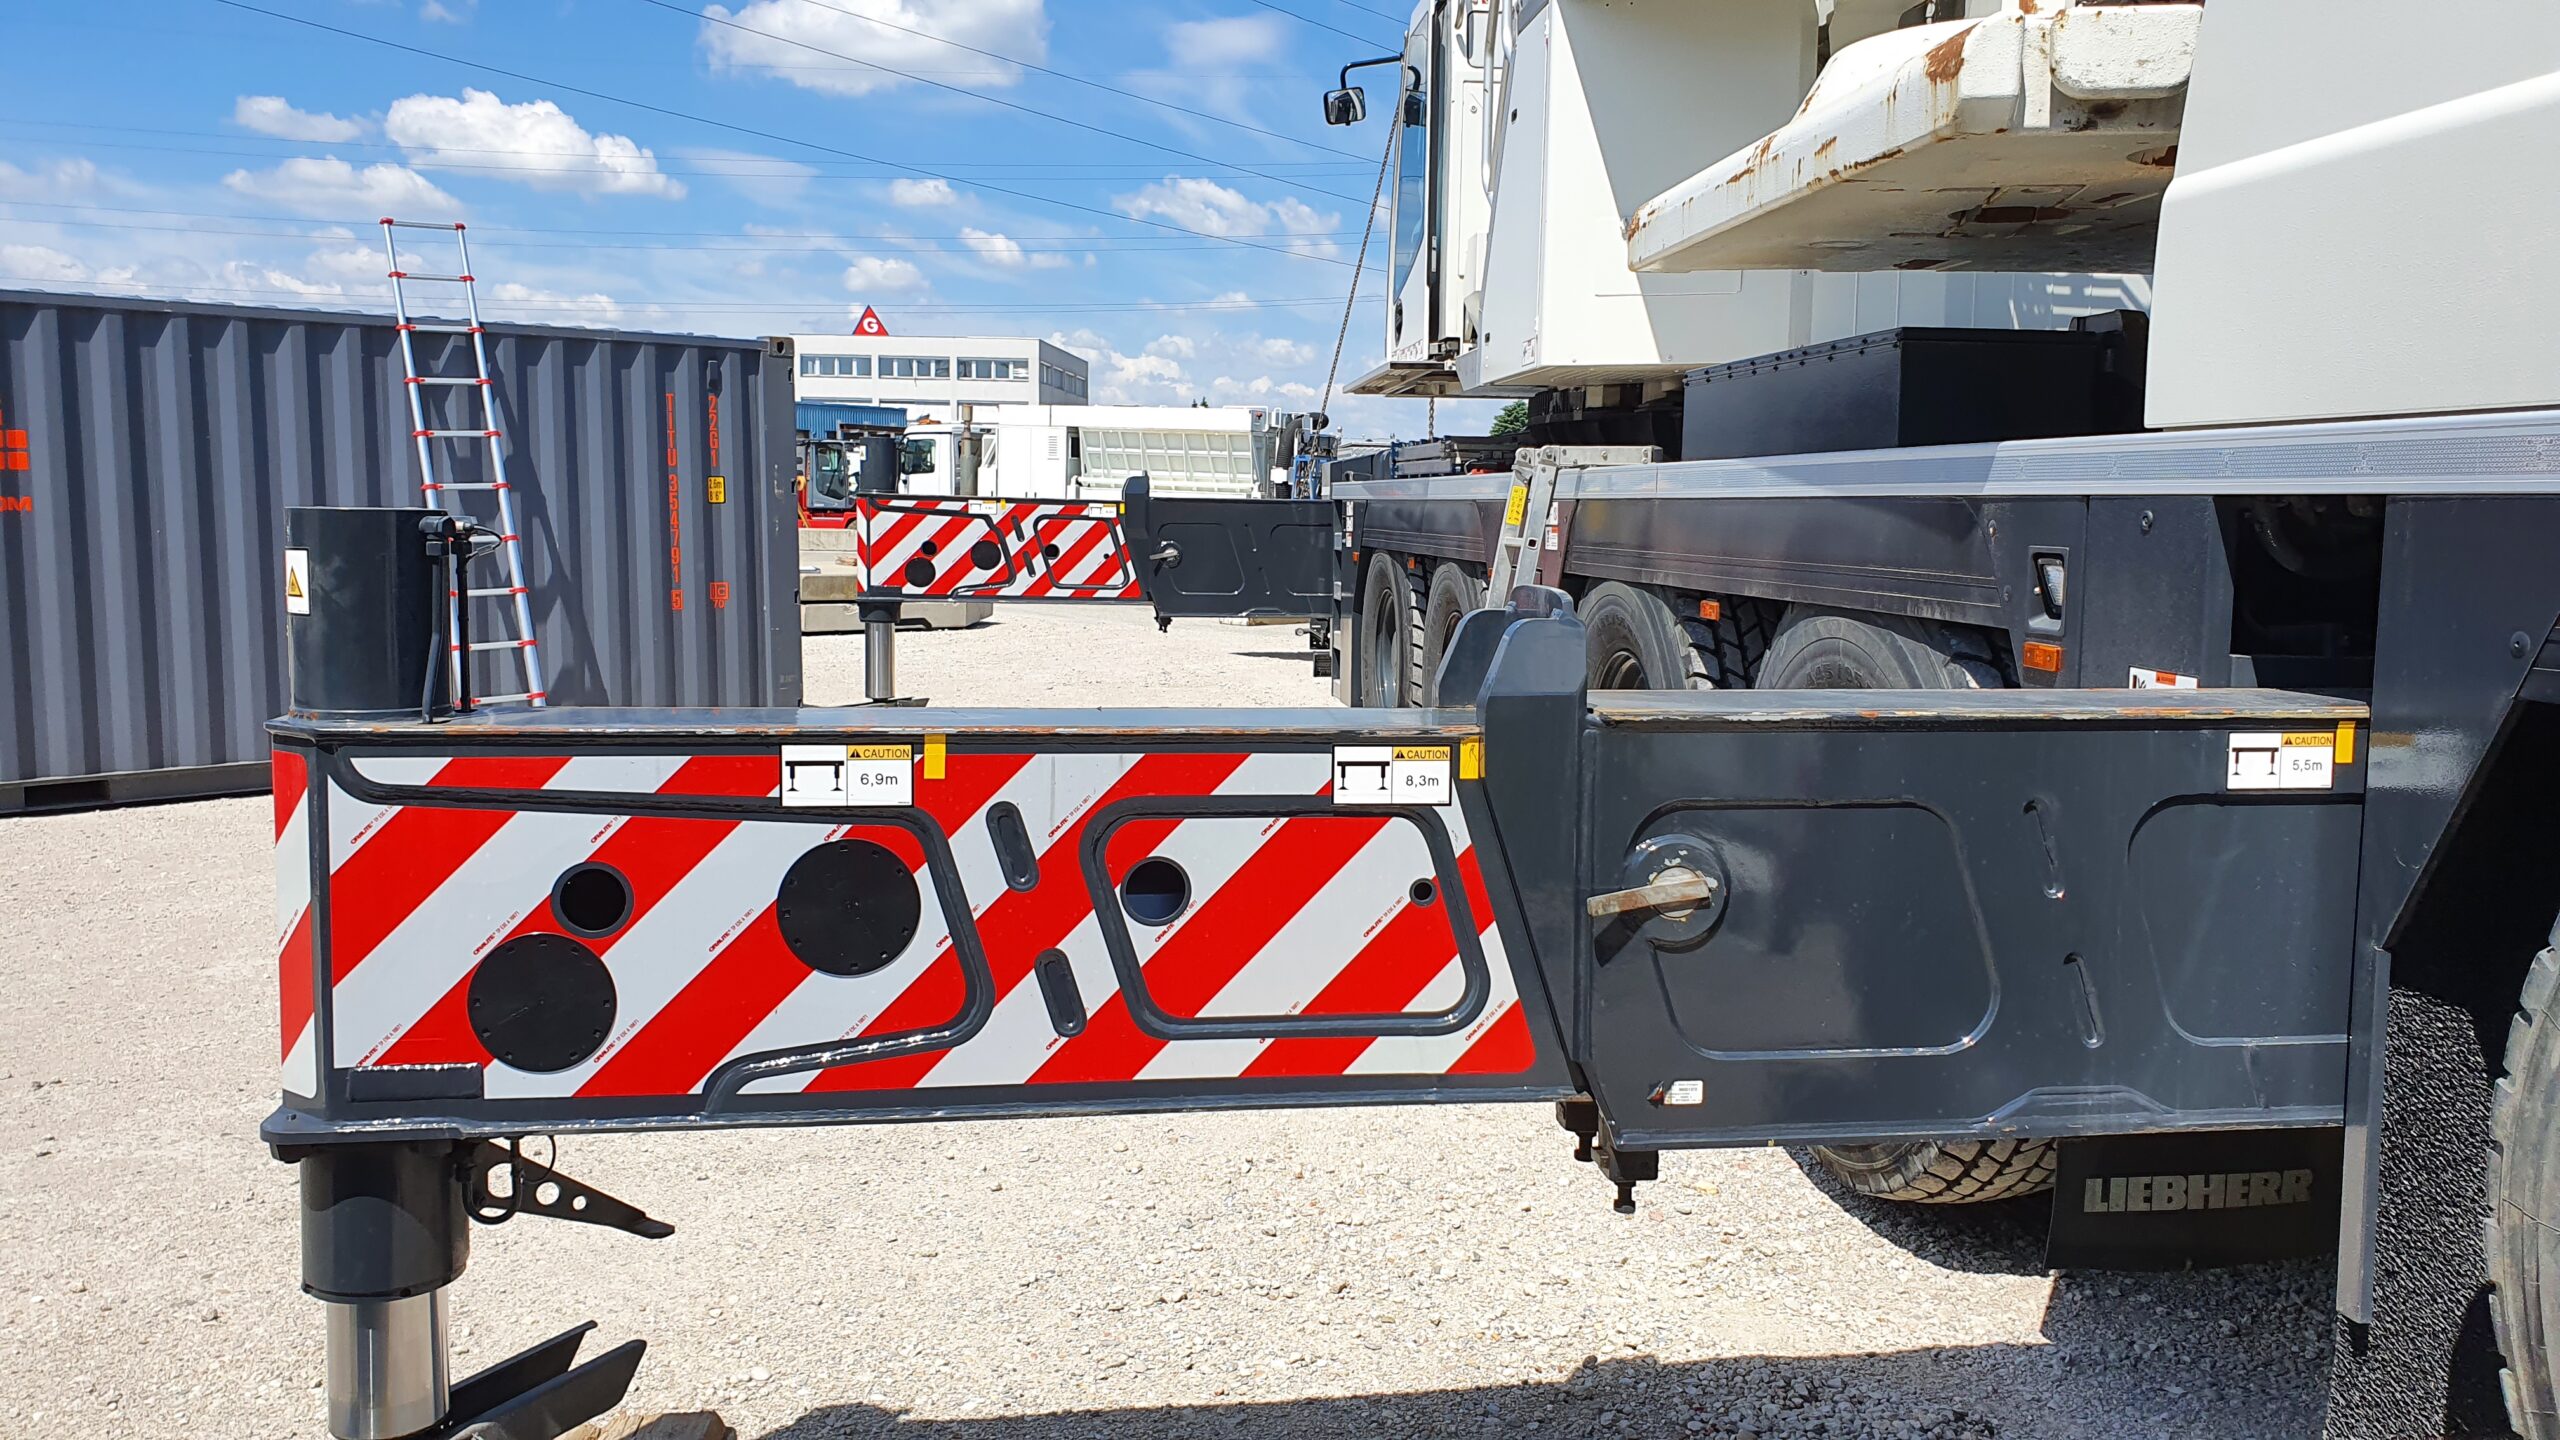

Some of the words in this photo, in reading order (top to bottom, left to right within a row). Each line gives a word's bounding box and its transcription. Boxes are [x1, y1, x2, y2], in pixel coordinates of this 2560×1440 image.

[863, 317, 879, 333] G
[665, 393, 678, 467] TITU
[708, 395, 719, 467] 22G1
[669, 474, 681, 583] 354791
[672, 590, 683, 610] 5
[2294, 736, 2332, 745] CAUTION
[863, 749, 910, 758] CAUTION
[1407, 750, 1448, 759] CAUTION
[2292, 759, 2322, 772] 5,5m
[860, 773, 898, 787] 6,9m
[1405, 775, 1439, 788] 8,3m
[2084, 1169, 2313, 1212] LIEBHERR
